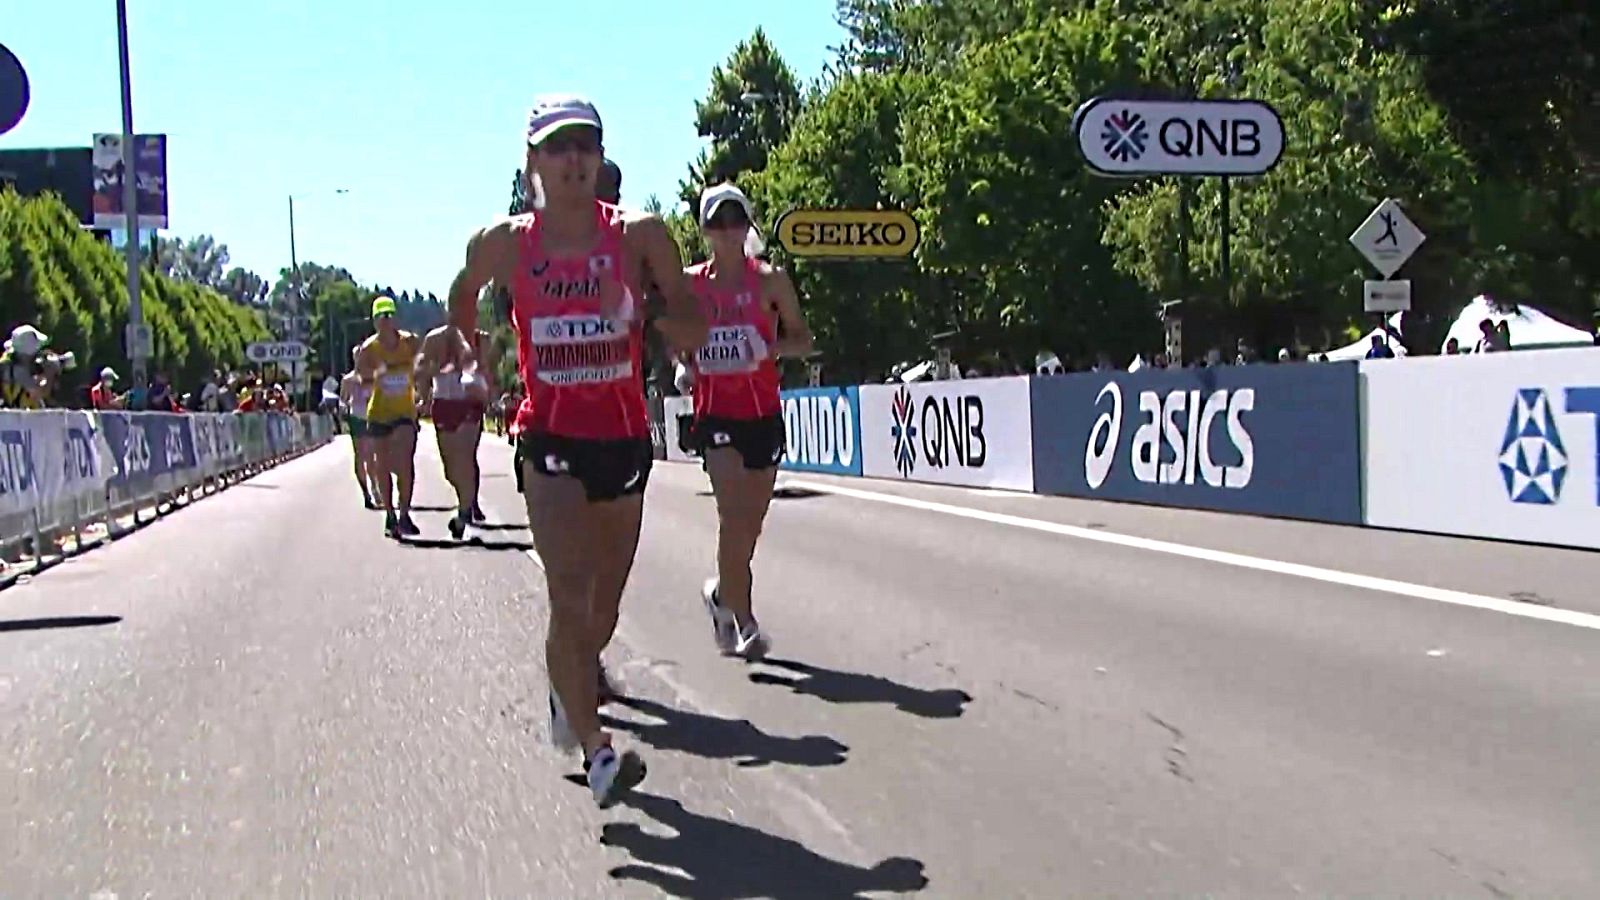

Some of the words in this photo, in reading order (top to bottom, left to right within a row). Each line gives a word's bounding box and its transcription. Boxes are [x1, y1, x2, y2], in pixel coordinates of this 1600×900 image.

[1159, 117, 1262, 158] QNB
[791, 222, 907, 246] SEIKO
[562, 319, 615, 338] TDK
[269, 344, 302, 357] QNB
[699, 344, 741, 361] IKEDA
[779, 396, 854, 467] ONDO
[921, 395, 987, 469] QNB
[1130, 387, 1256, 489] asics
